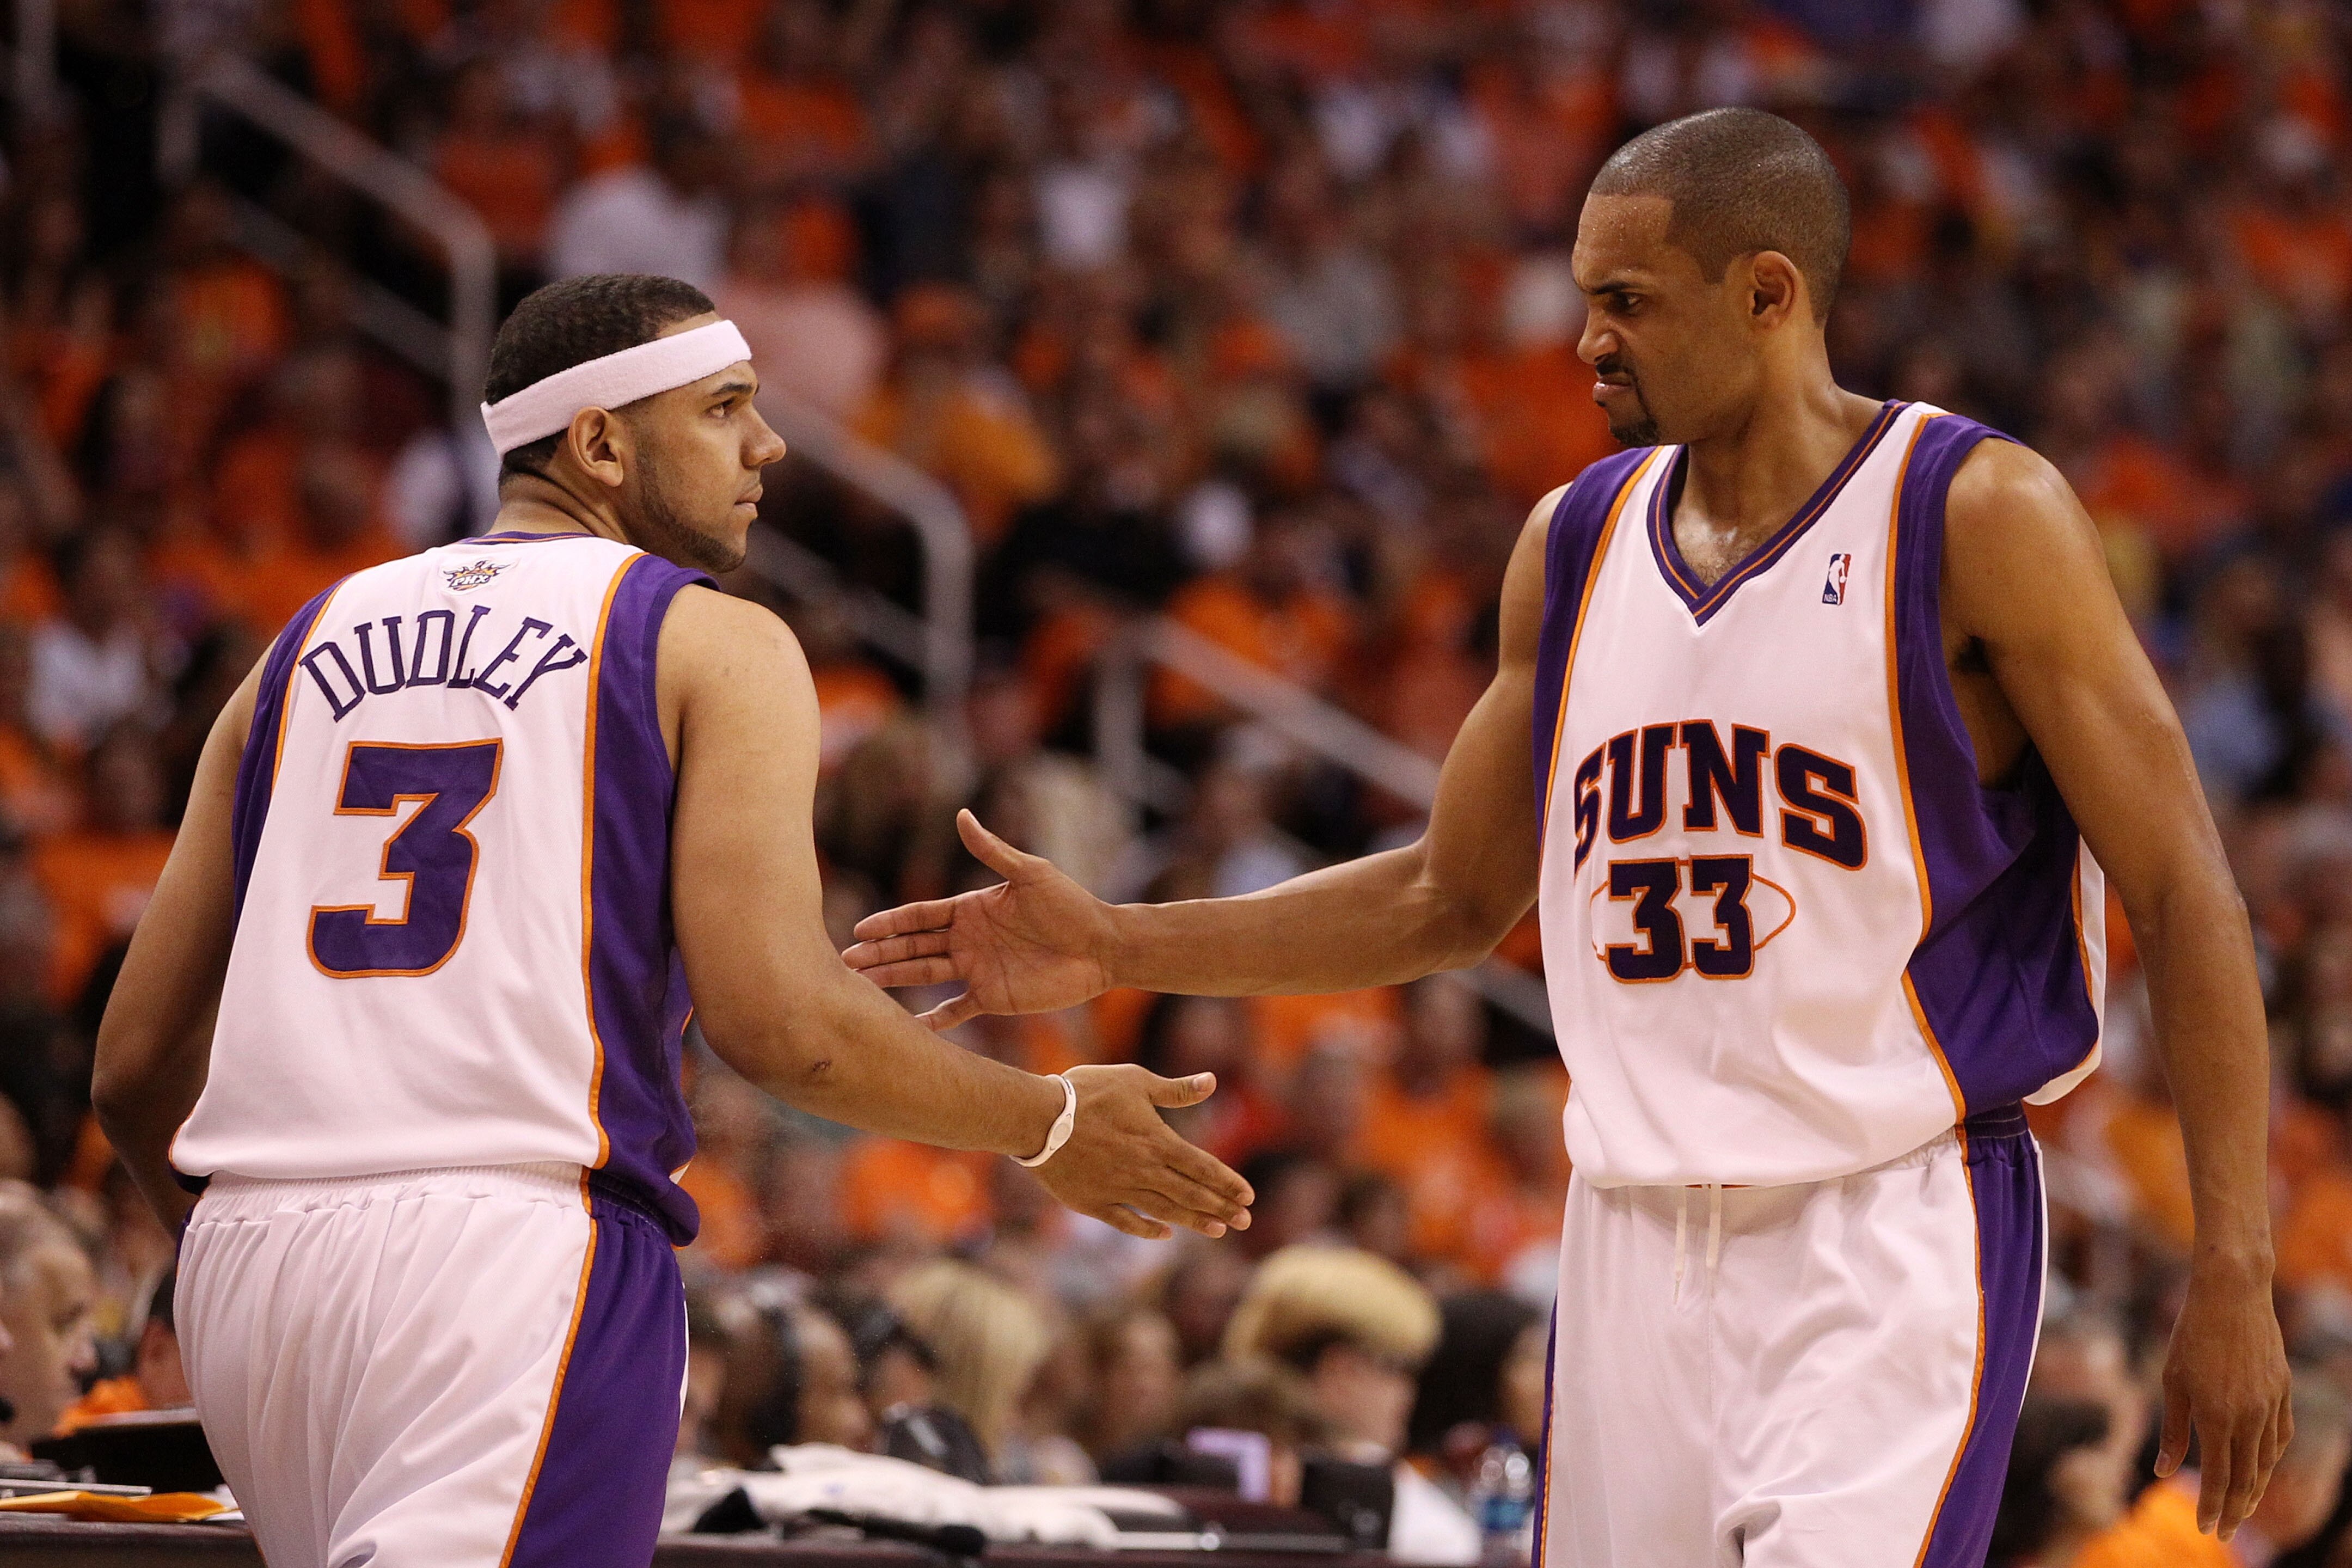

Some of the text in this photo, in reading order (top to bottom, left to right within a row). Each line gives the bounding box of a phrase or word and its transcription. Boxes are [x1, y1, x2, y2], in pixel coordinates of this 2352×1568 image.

[451, 574, 489, 586] PHX
[1823, 593, 1837, 602] NBA
[298, 605, 588, 722] DUDLEY
[306, 737, 503, 978] 3
[1574, 719, 1868, 883] SUNS
[1604, 854, 1754, 984] 33
